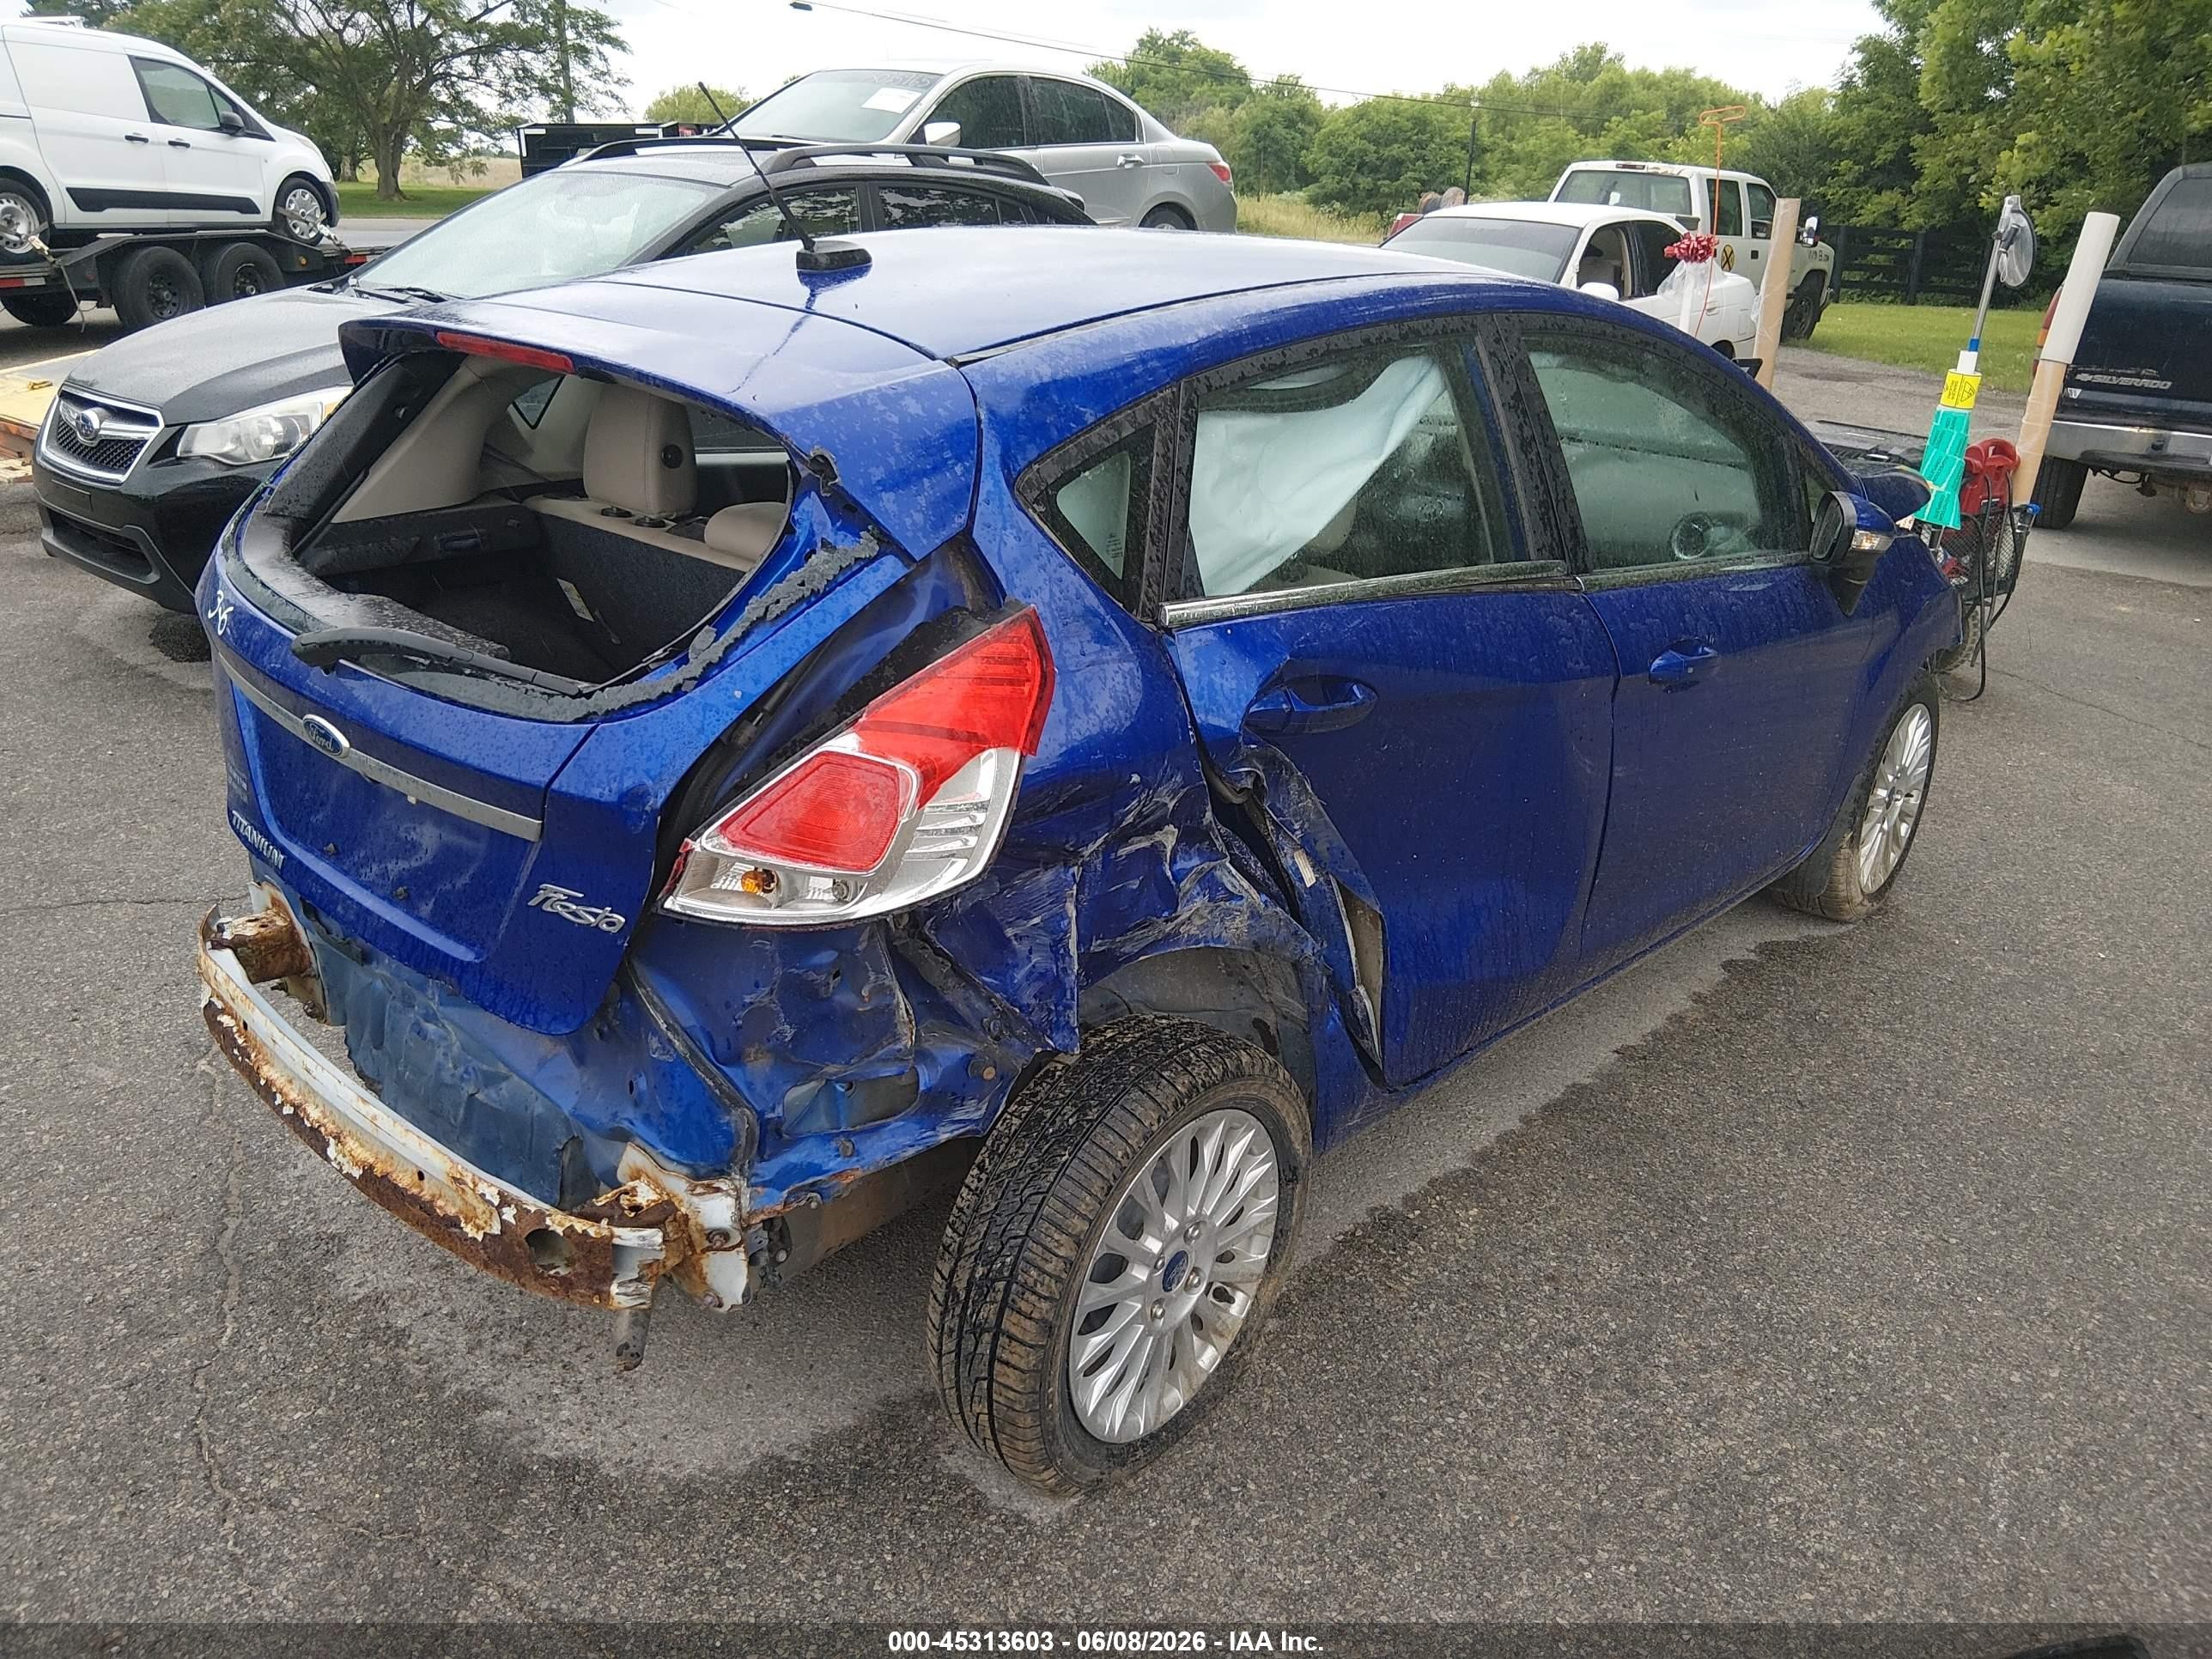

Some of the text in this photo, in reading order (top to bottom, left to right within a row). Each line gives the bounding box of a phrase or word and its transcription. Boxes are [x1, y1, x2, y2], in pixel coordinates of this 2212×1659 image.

[2091, 374, 2172, 389] SILVERADO
[309, 723, 334, 751] Ford
[232, 810, 285, 870] TITANIUM
[527, 883, 626, 933] Fiesta
